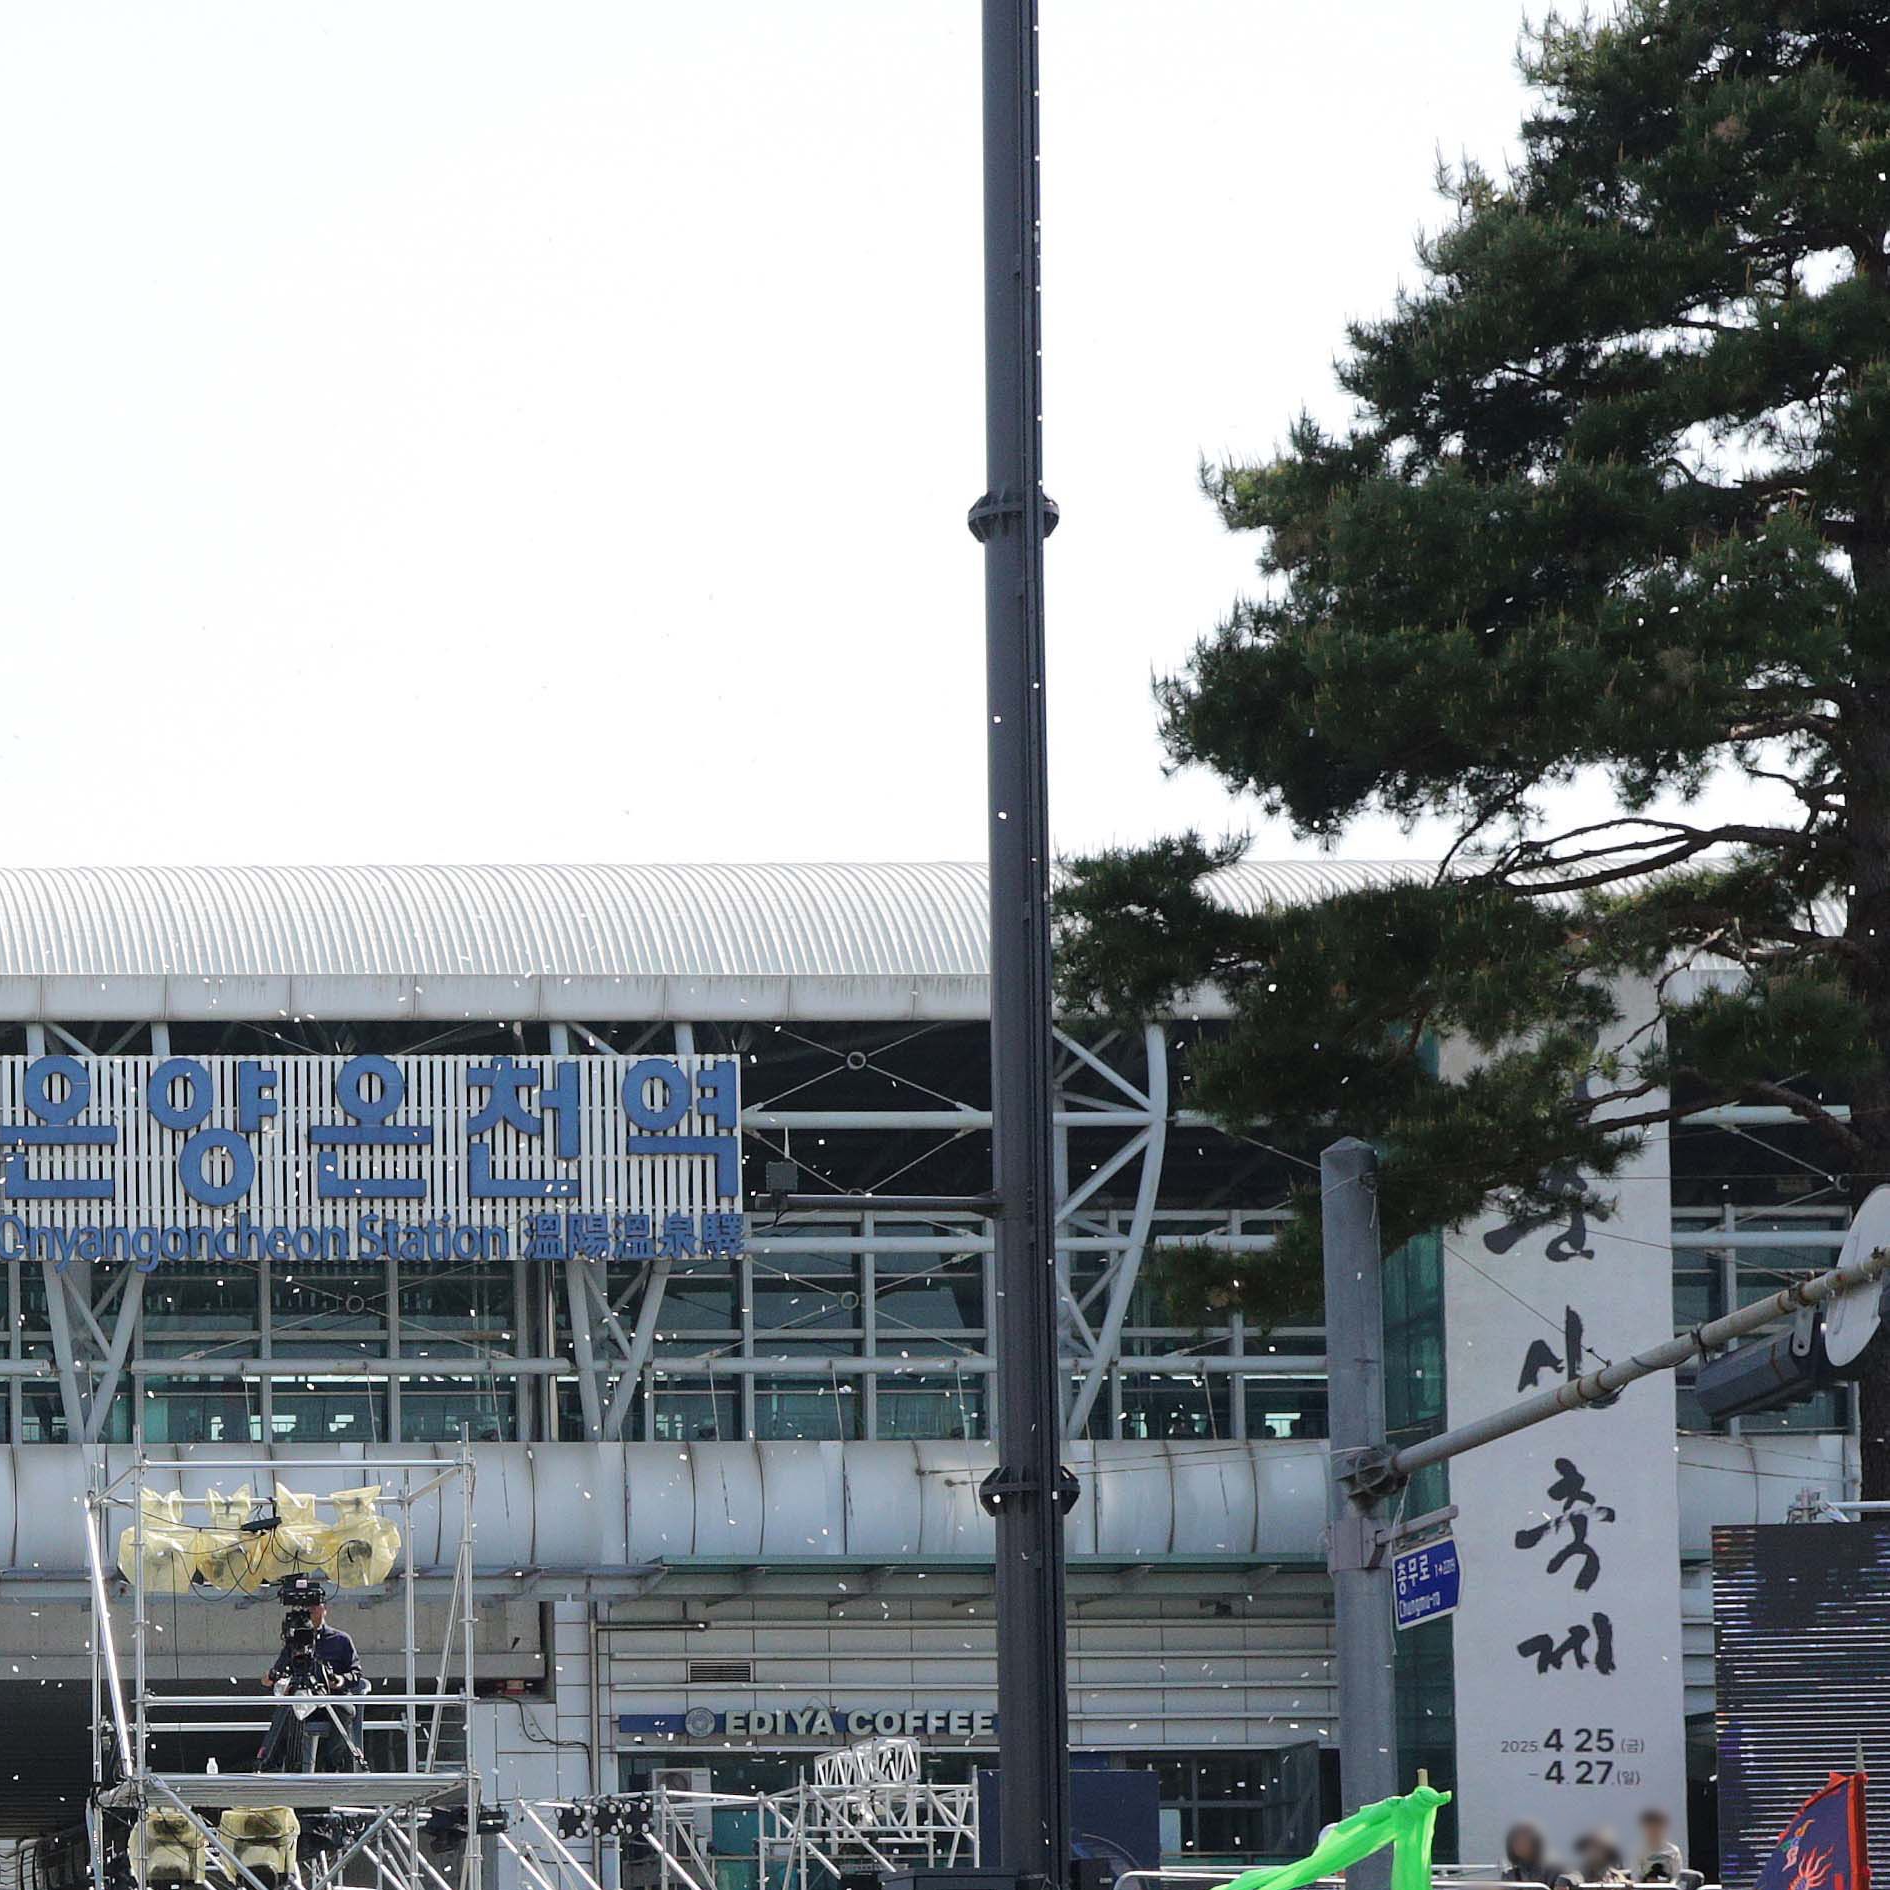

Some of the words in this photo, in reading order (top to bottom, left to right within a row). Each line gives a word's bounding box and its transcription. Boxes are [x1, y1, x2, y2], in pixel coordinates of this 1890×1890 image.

[356, 1213, 510, 1262] Station
[1396, 1553, 1431, 1596] 충무로
[724, 1710, 837, 1737] EDIYA
[847, 1708, 995, 1737] COFFEE
